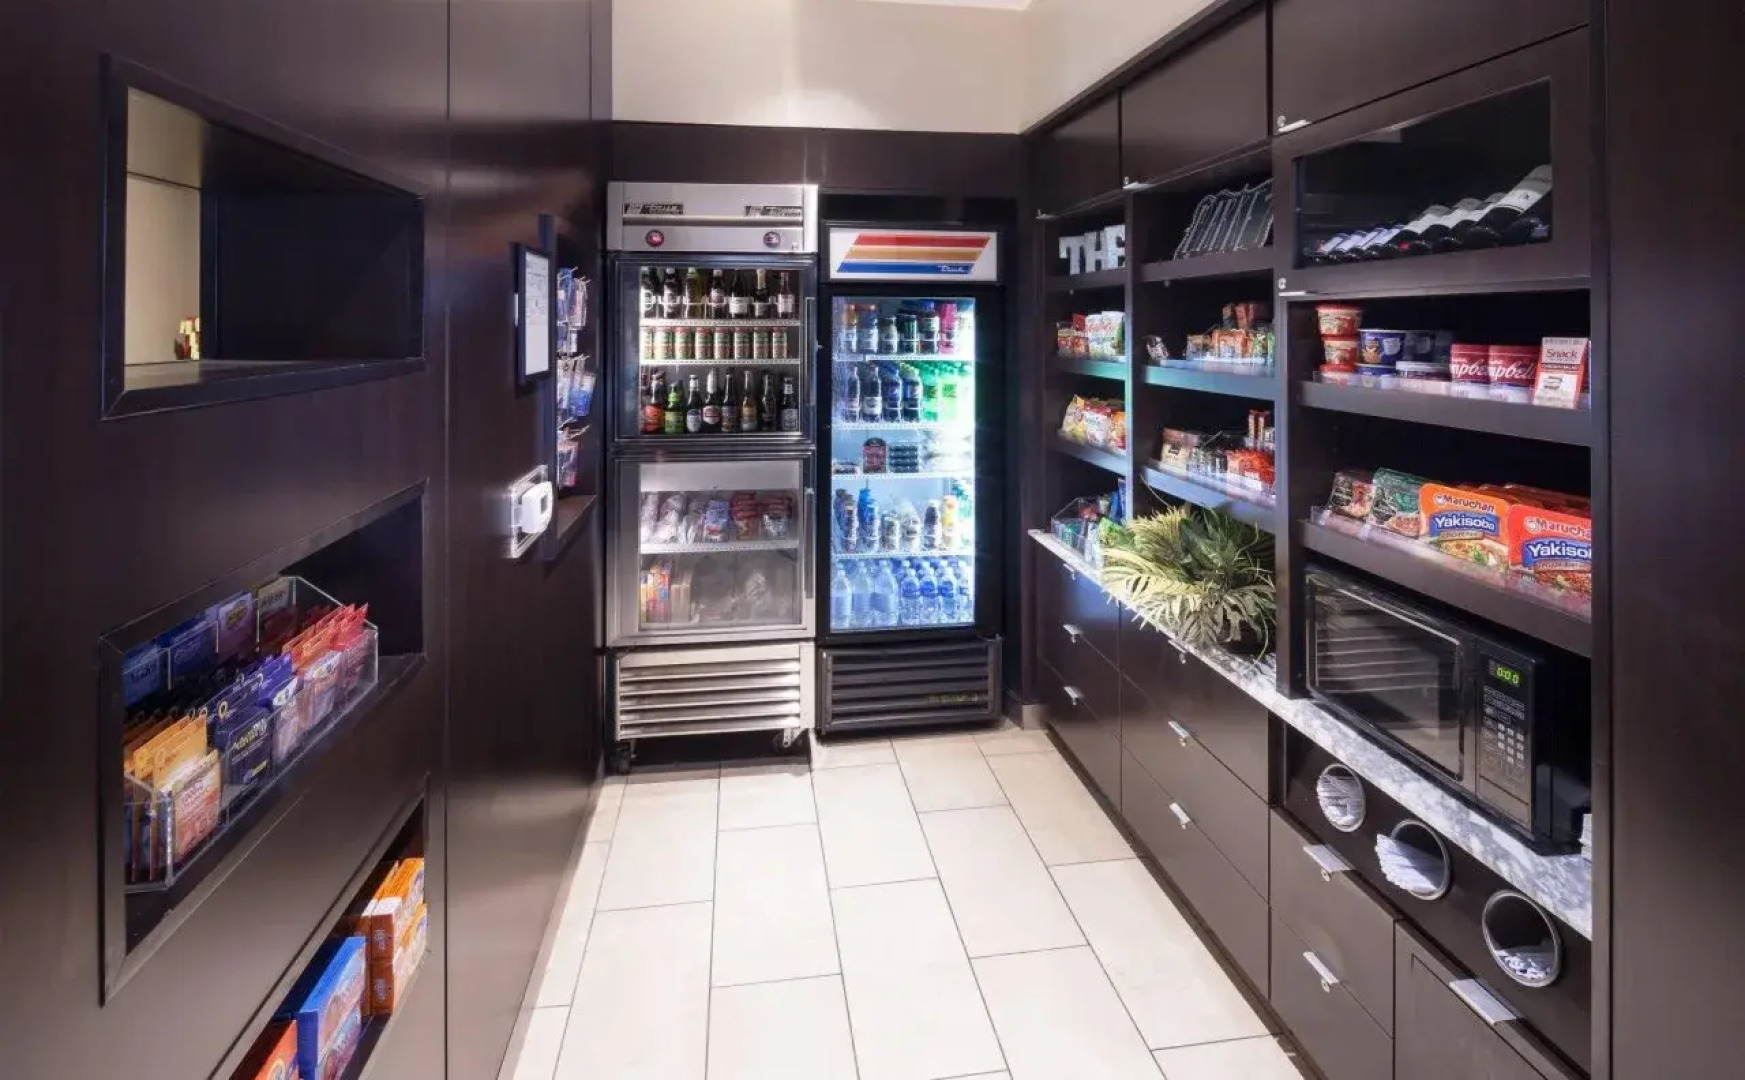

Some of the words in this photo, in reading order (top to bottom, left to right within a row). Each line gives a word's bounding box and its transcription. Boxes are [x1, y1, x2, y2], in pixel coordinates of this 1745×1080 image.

[1546, 348, 1578, 359] Snack
[1442, 493, 1495, 513] Maruchan
[1434, 513, 1496, 531] Yakisoba
[1536, 517, 1591, 539] Marucha
[1527, 541, 1591, 558] Yakiso
